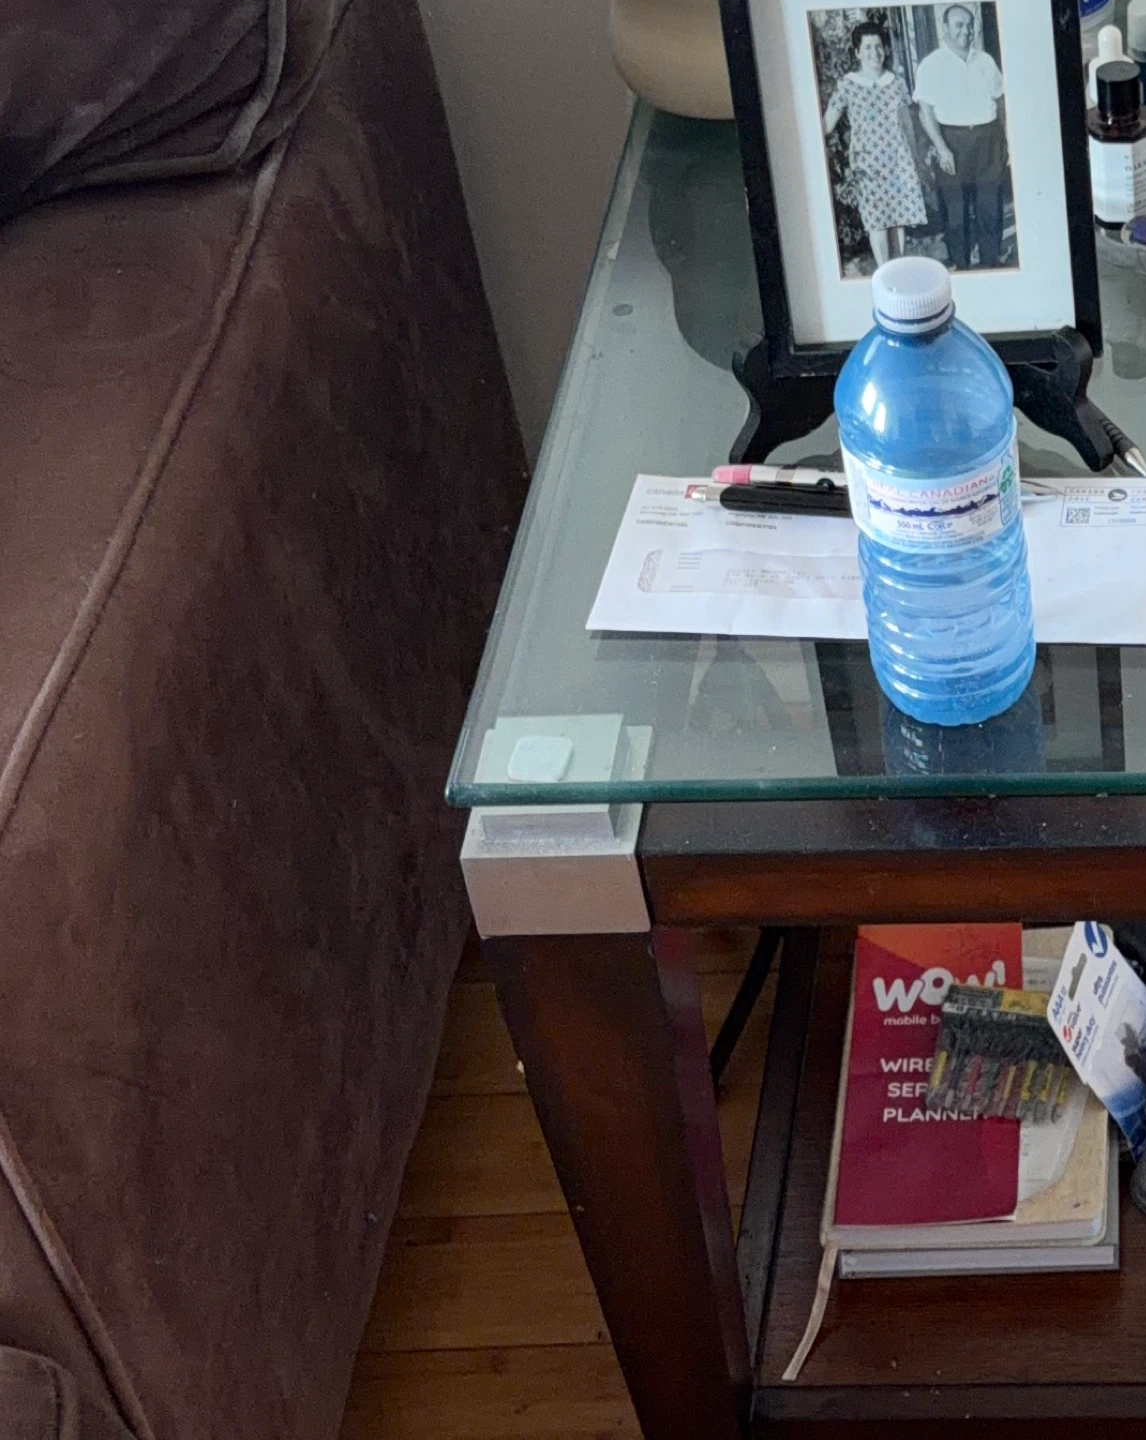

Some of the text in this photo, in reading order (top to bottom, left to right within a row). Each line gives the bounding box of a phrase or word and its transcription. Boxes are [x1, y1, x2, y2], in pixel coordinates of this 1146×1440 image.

[908, 475, 989, 499] CANADIAN
[884, 1013, 927, 1026] mobile
[880, 1058, 935, 1073] WIRE
